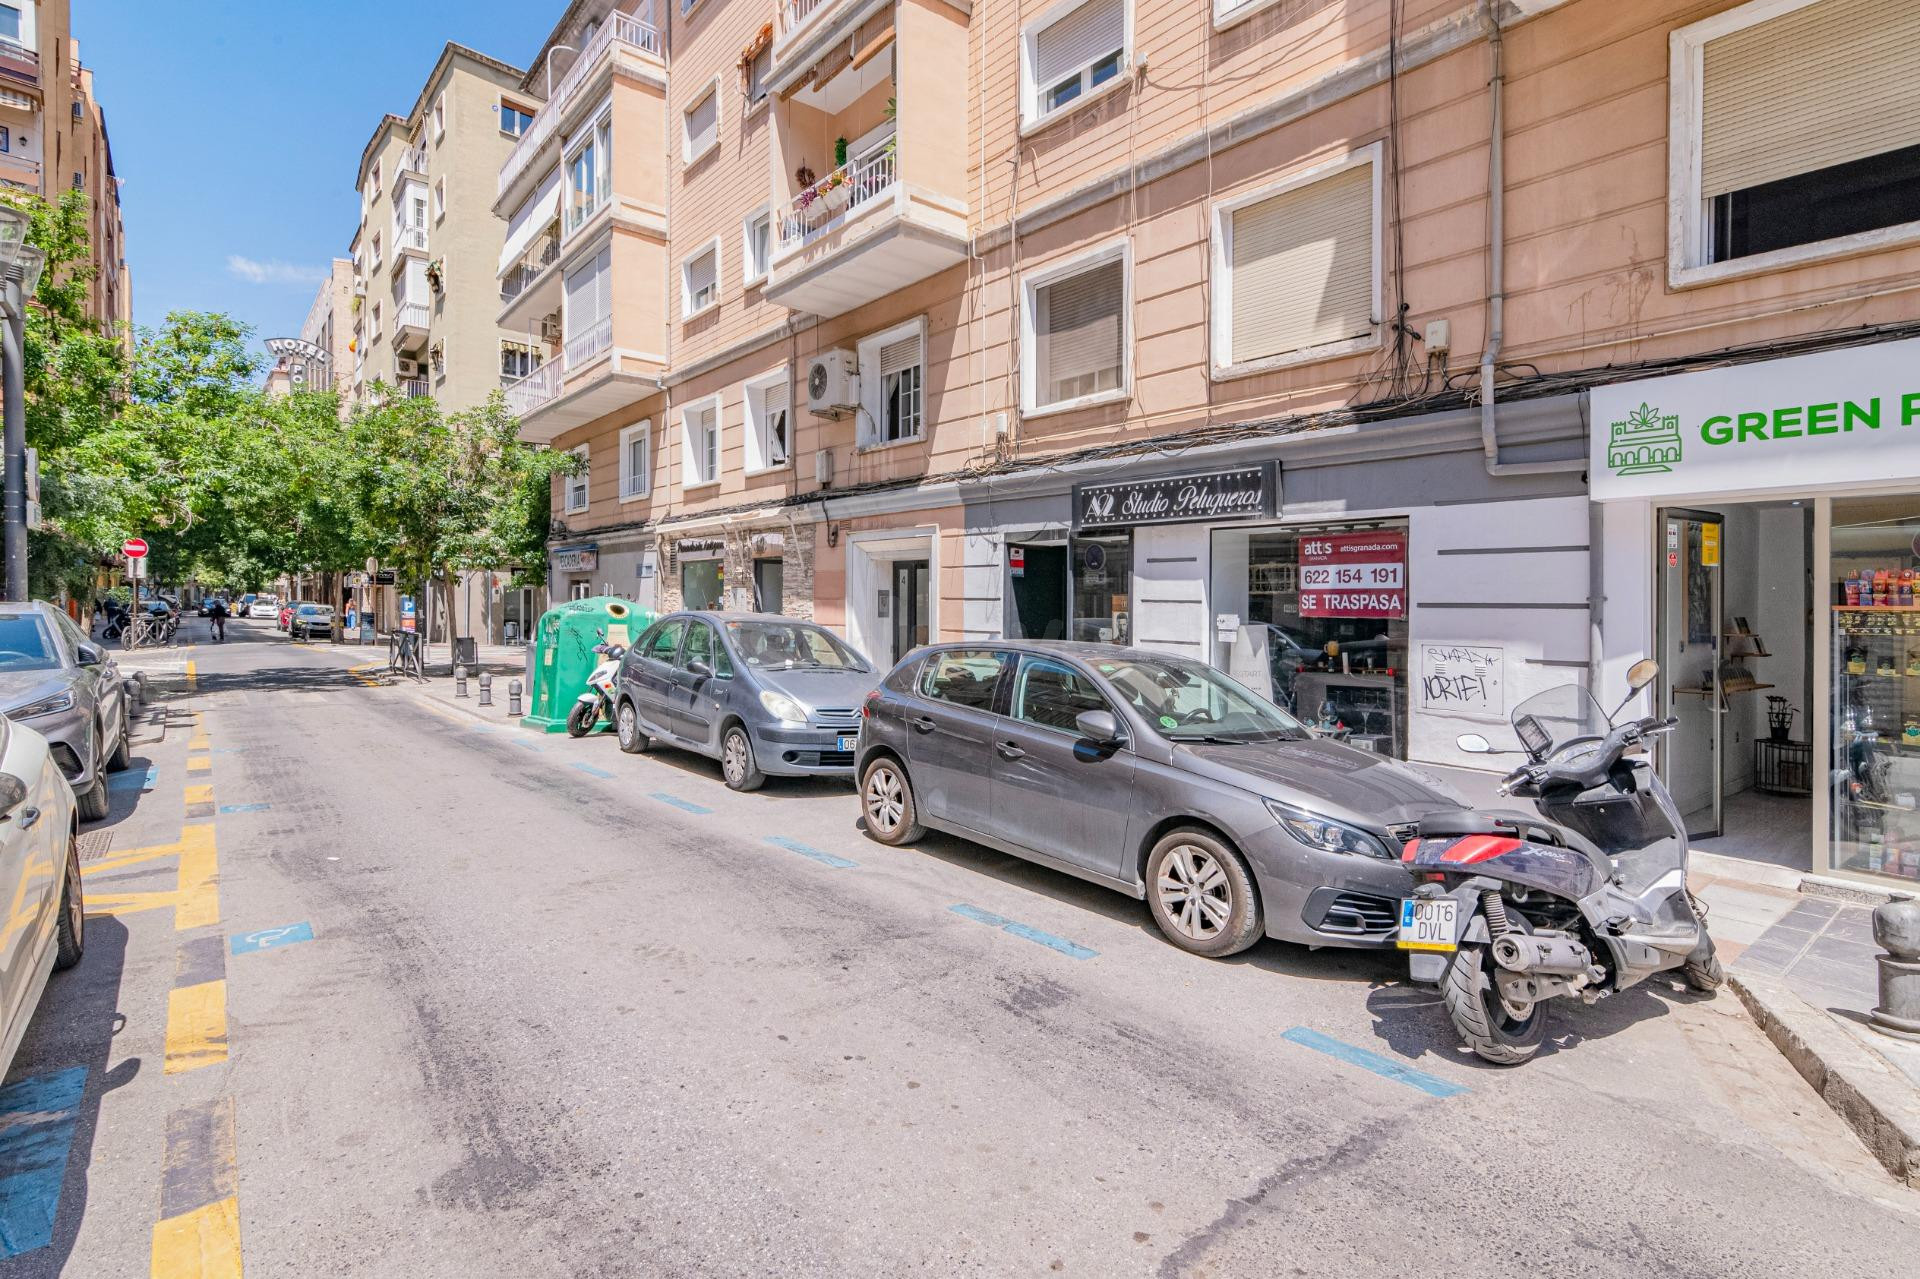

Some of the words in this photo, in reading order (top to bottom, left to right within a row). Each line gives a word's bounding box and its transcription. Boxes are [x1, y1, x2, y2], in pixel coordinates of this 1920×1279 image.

[270, 339, 325, 362] HOTEL
[1700, 397, 1880, 445] GREEN
[1121, 492, 1169, 515] Studio
[1173, 485, 1262, 516] Peluqueros
[1340, 543, 1398, 553] attisgranada.com
[1305, 570, 1329, 584] 622
[1335, 568, 1362, 583] 154
[1370, 567, 1397, 583] 191
[1301, 594, 1317, 609] SE
[1322, 594, 1401, 610] TRASPASA
[1415, 903, 1453, 921] 0016
[1418, 922, 1447, 940] DVL
